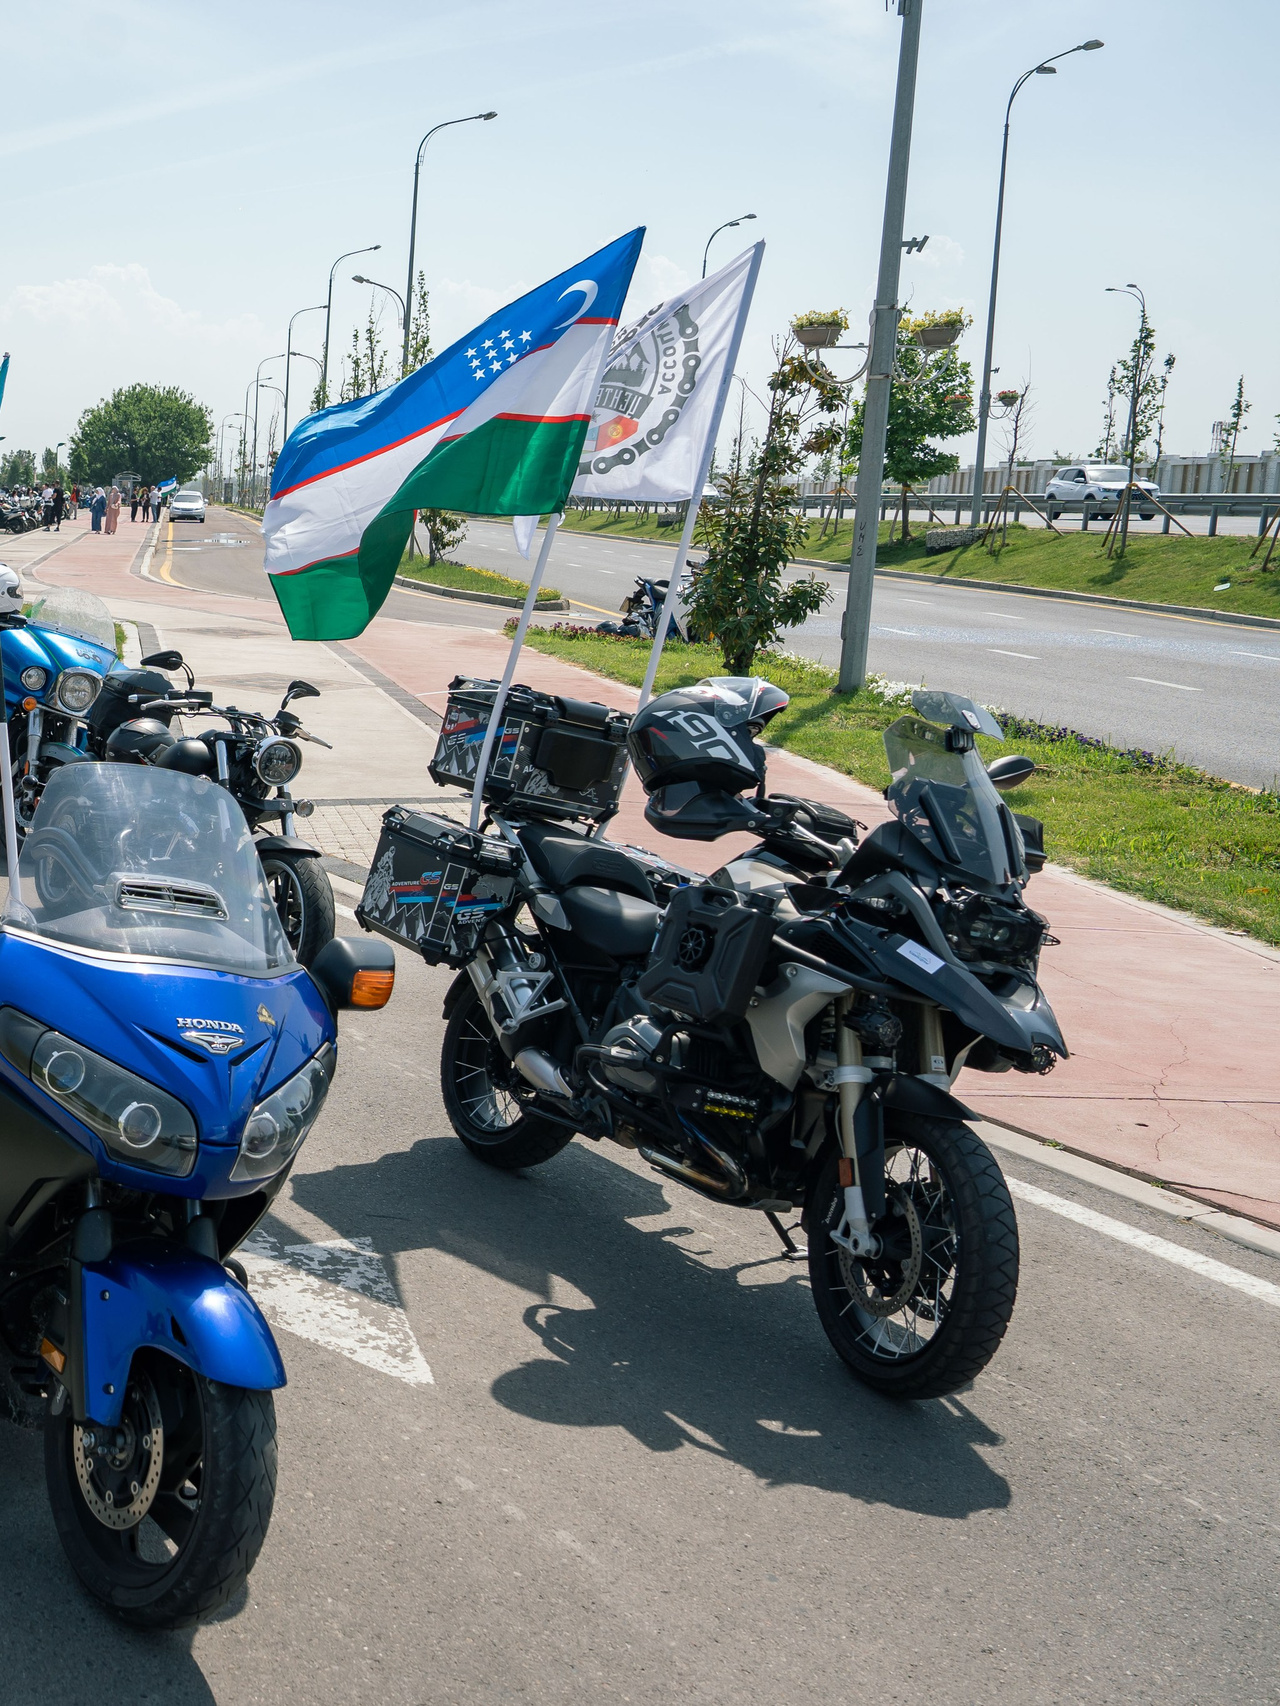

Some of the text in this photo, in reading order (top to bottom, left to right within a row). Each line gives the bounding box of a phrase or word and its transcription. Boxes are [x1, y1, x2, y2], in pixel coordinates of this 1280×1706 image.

[420, 871, 443, 885] GS
[443, 883, 459, 891] GS
[456, 907, 486, 921] GS
[176, 1017, 246, 1034] HONDA
